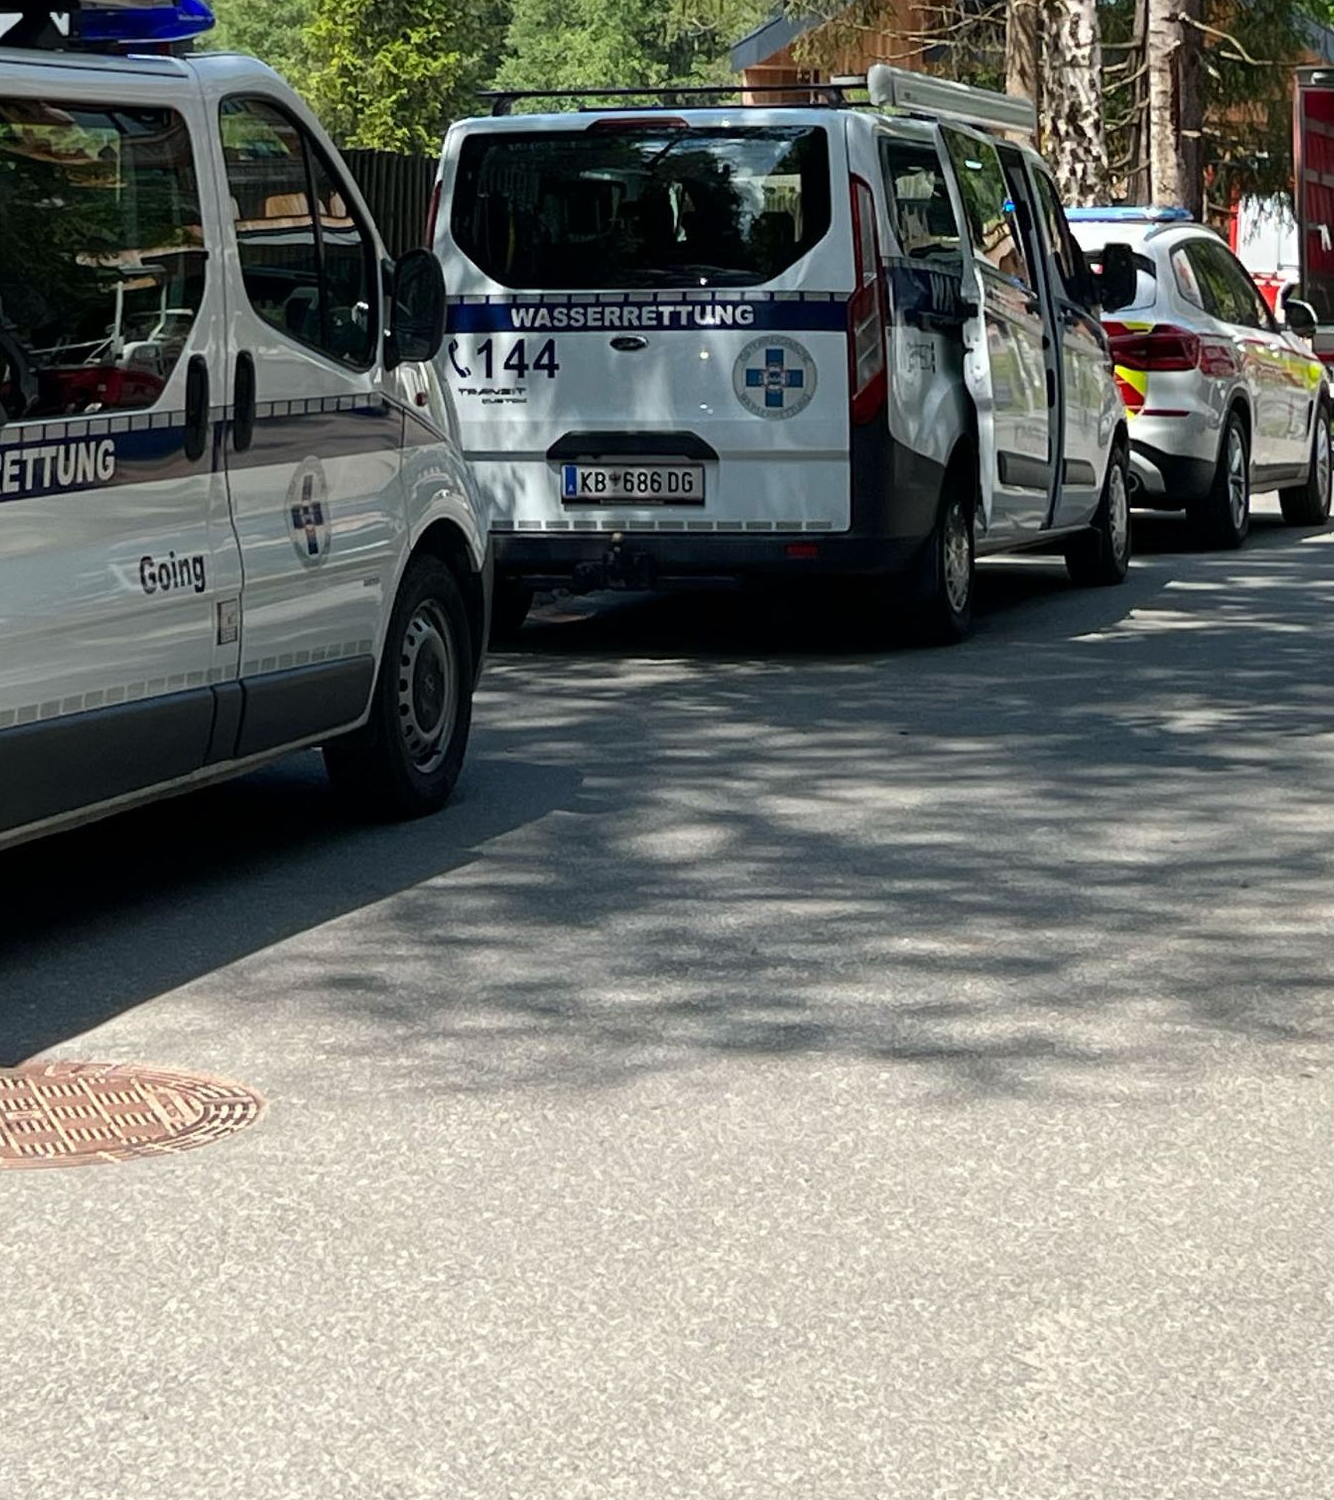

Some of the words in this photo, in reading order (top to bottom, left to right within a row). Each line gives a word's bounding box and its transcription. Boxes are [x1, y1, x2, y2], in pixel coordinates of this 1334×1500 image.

[511, 305, 755, 328] WASSERRETTUNG
[476, 339, 560, 379] 144
[580, 471, 607, 492] KB
[623, 471, 662, 493] 686
[667, 471, 693, 493] DG
[139, 550, 206, 595] Going
